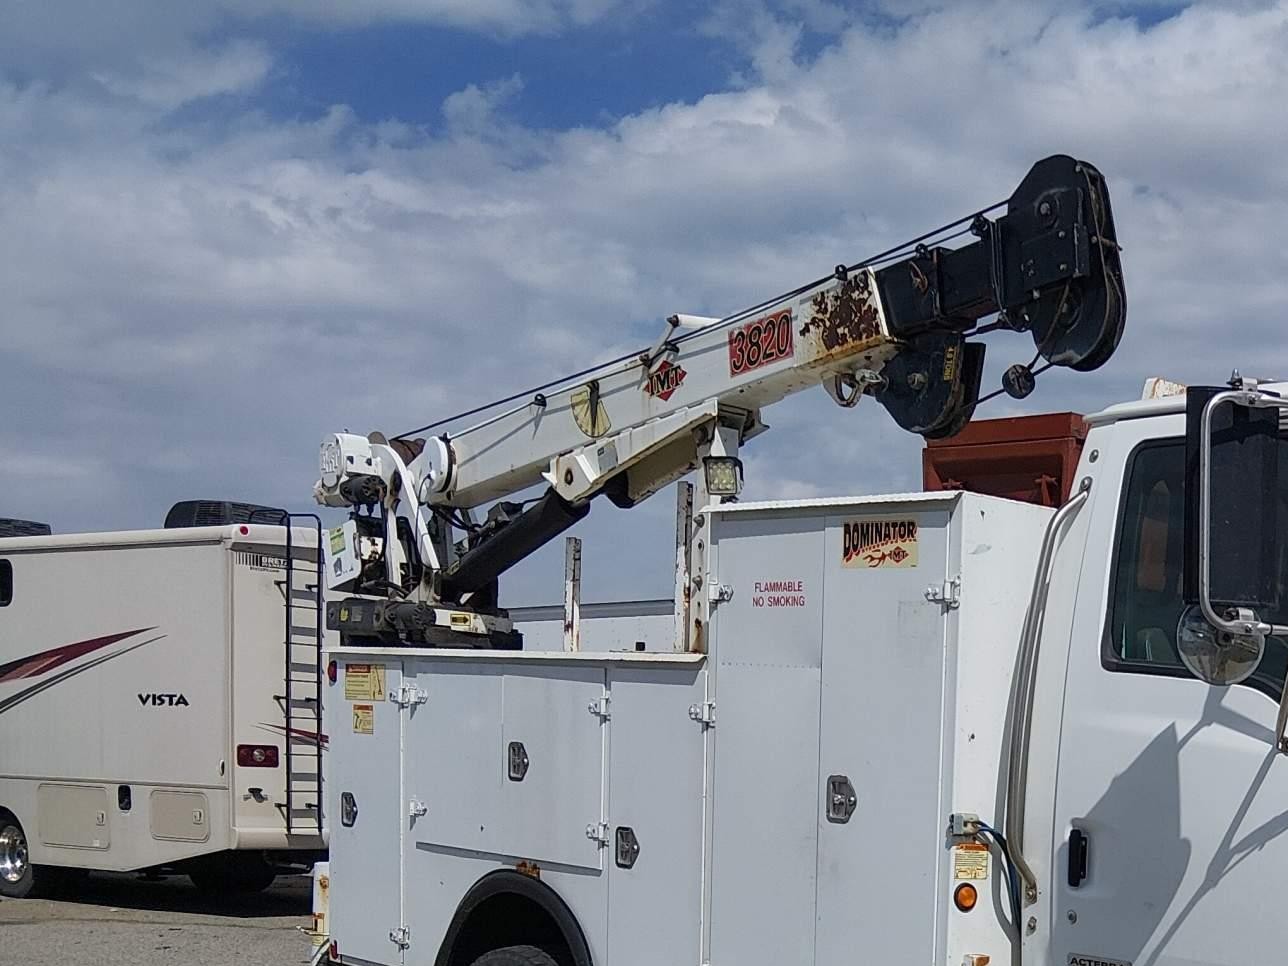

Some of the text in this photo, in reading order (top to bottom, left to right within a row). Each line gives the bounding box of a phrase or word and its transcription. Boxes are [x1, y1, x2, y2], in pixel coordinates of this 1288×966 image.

[731, 312, 791, 373] 3820
[649, 364, 685, 397] IMT
[843, 521, 917, 559] DOMINATOR
[754, 581, 803, 593] FLAMMABLE
[752, 595, 805, 607] NO SMOKING
[137, 693, 190, 706] VISTA
